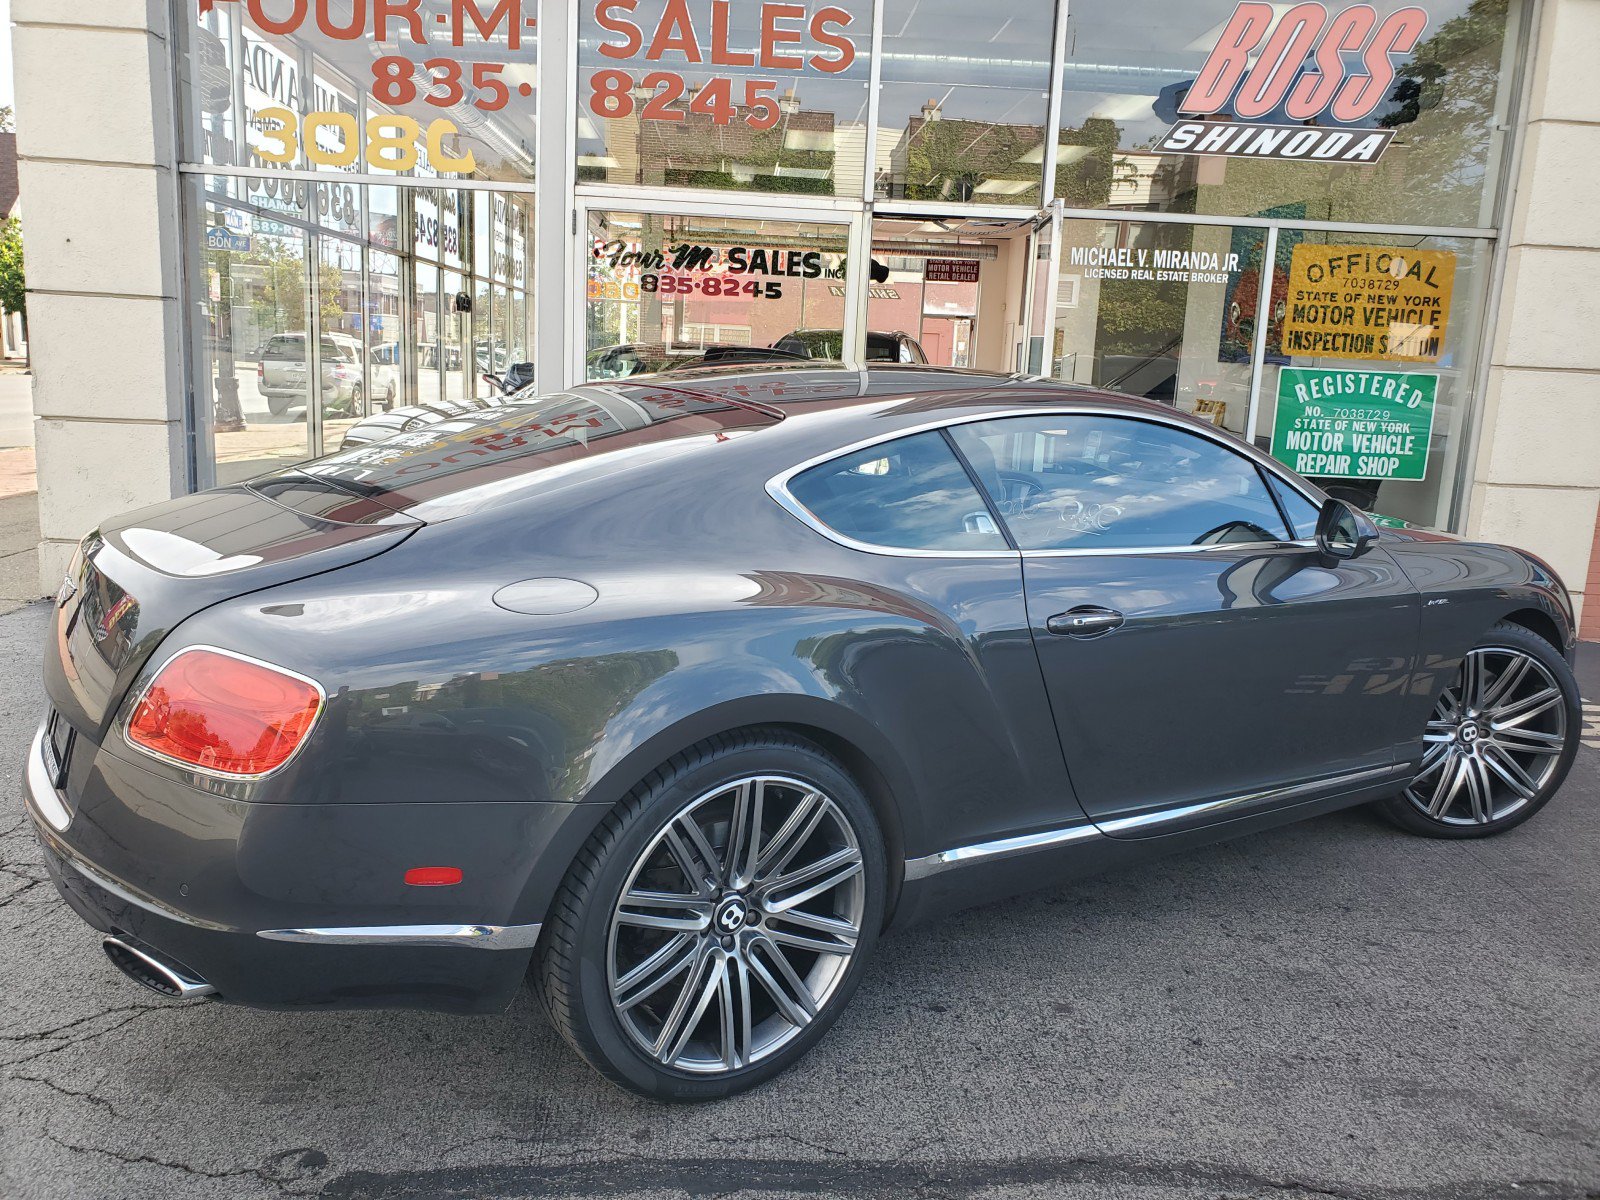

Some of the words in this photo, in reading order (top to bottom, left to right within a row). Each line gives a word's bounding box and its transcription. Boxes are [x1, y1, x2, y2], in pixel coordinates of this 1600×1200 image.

[594, 0, 856, 74] SALES
[1177, 1, 1429, 122] BOSS
[589, 69, 782, 130] 8245
[1163, 124, 1386, 161] SHINODA
[728, 246, 821, 279] SALES
[928, 264, 950, 272] MOTOR
[952, 265, 978, 273] VEHICLE
[1071, 247, 1134, 268] MICHAEL
[1137, 250, 1149, 268] V.
[1153, 250, 1218, 271] MIRANDA
[1221, 253, 1242, 273] JR.
[1306, 252, 1440, 290] OFFICIAL
[928, 272, 951, 280] RETAIL
[1084, 268, 1128, 280] LICENSED
[1130, 269, 1154, 281] REAL
[1156, 270, 1189, 282] ESTATE
[1191, 272, 1229, 284] BROKER
[1342, 277, 1400, 291] 7038729
[1296, 290, 1338, 303] STATE
[1343, 293, 1362, 303] OF
[1367, 294, 1399, 305] NEW
[1403, 295, 1441, 307] YORK
[1292, 303, 1356, 326] MOTOR
[1363, 306, 1442, 330] VEHICLE
[1287, 330, 1375, 354] INSPECTION
[1379, 334, 1440, 357] SION
[1294, 373, 1423, 409] REGISTERED
[1304, 405, 1324, 417] NO.
[1333, 408, 1391, 420] 7038729
[1294, 418, 1331, 431] STATE
[1334, 420, 1348, 431] OF
[1352, 421, 1377, 432] NEW
[1381, 422, 1411, 434] YORK
[1285, 430, 1344, 453] MOTOR
[1352, 433, 1416, 456] VEHICLE
[1295, 453, 1351, 475] REPAIR
[1357, 456, 1400, 477] SHOP
